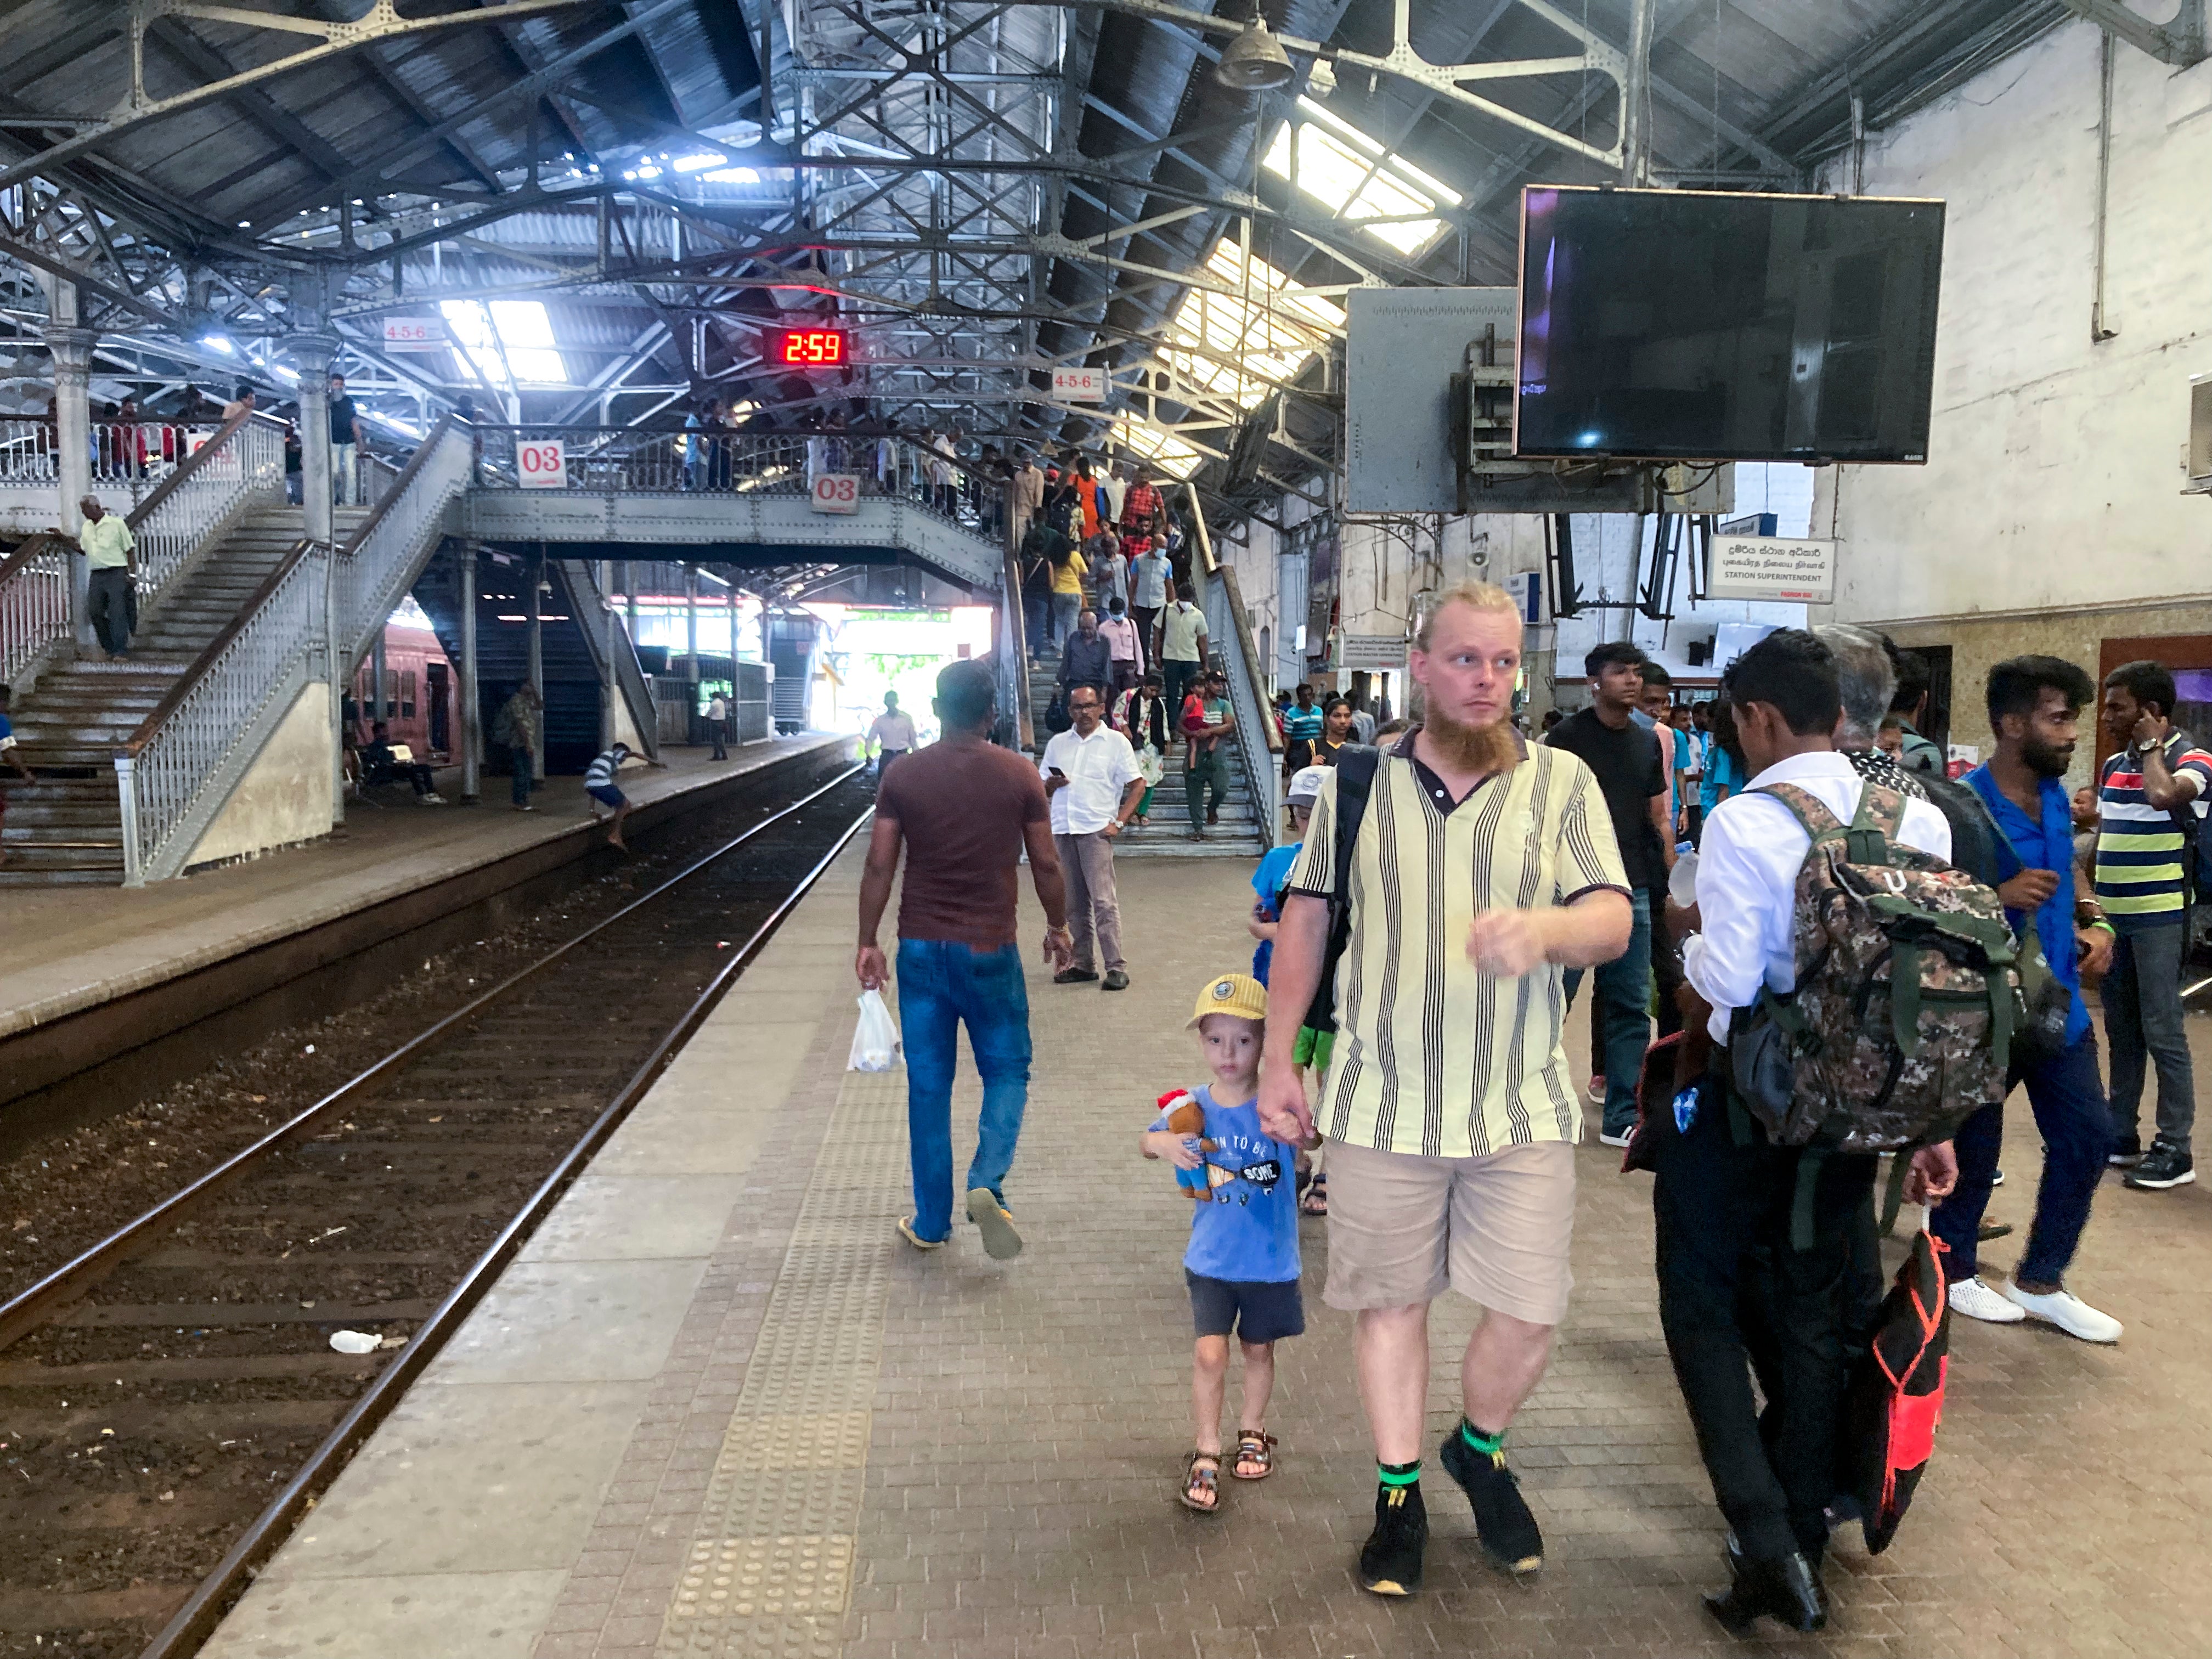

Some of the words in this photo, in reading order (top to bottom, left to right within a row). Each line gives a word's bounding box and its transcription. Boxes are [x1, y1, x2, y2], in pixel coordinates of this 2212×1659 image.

[787, 334, 840, 361] 2:59
[1055, 375, 1091, 388] 4-5-6
[522, 446, 561, 473] 03
[817, 478, 855, 501] 03
[1757, 572, 1821, 582] SUPERINTENDENT
[1234, 1136, 1248, 1150] TO
[1252, 1141, 1268, 1158] BE
[1243, 1163, 1277, 1181] SOME
